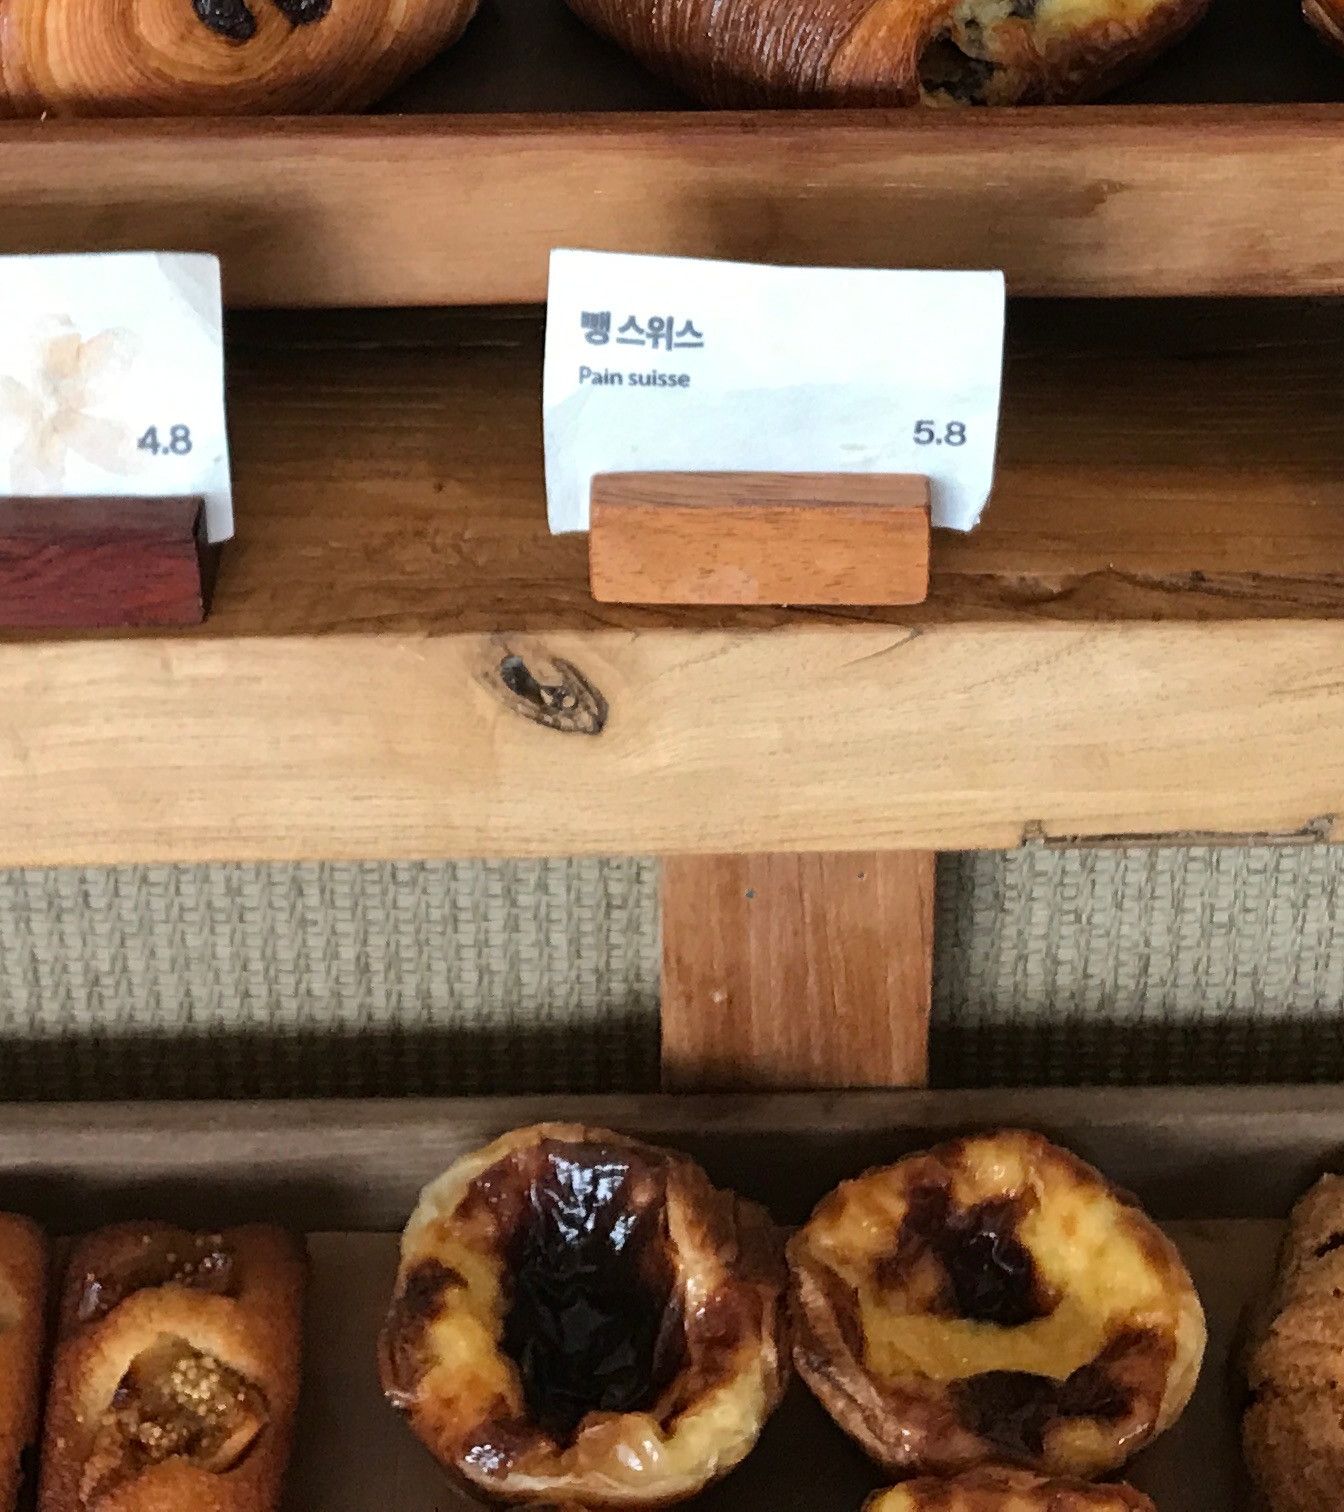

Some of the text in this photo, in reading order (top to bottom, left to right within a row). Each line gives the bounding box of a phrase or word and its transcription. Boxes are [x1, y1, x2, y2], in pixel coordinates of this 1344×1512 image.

[615, 315, 706, 353] 스위스
[578, 365, 692, 390] Pain suisse
[136, 424, 195, 457] 4.8
[912, 419, 969, 448] 5.8
